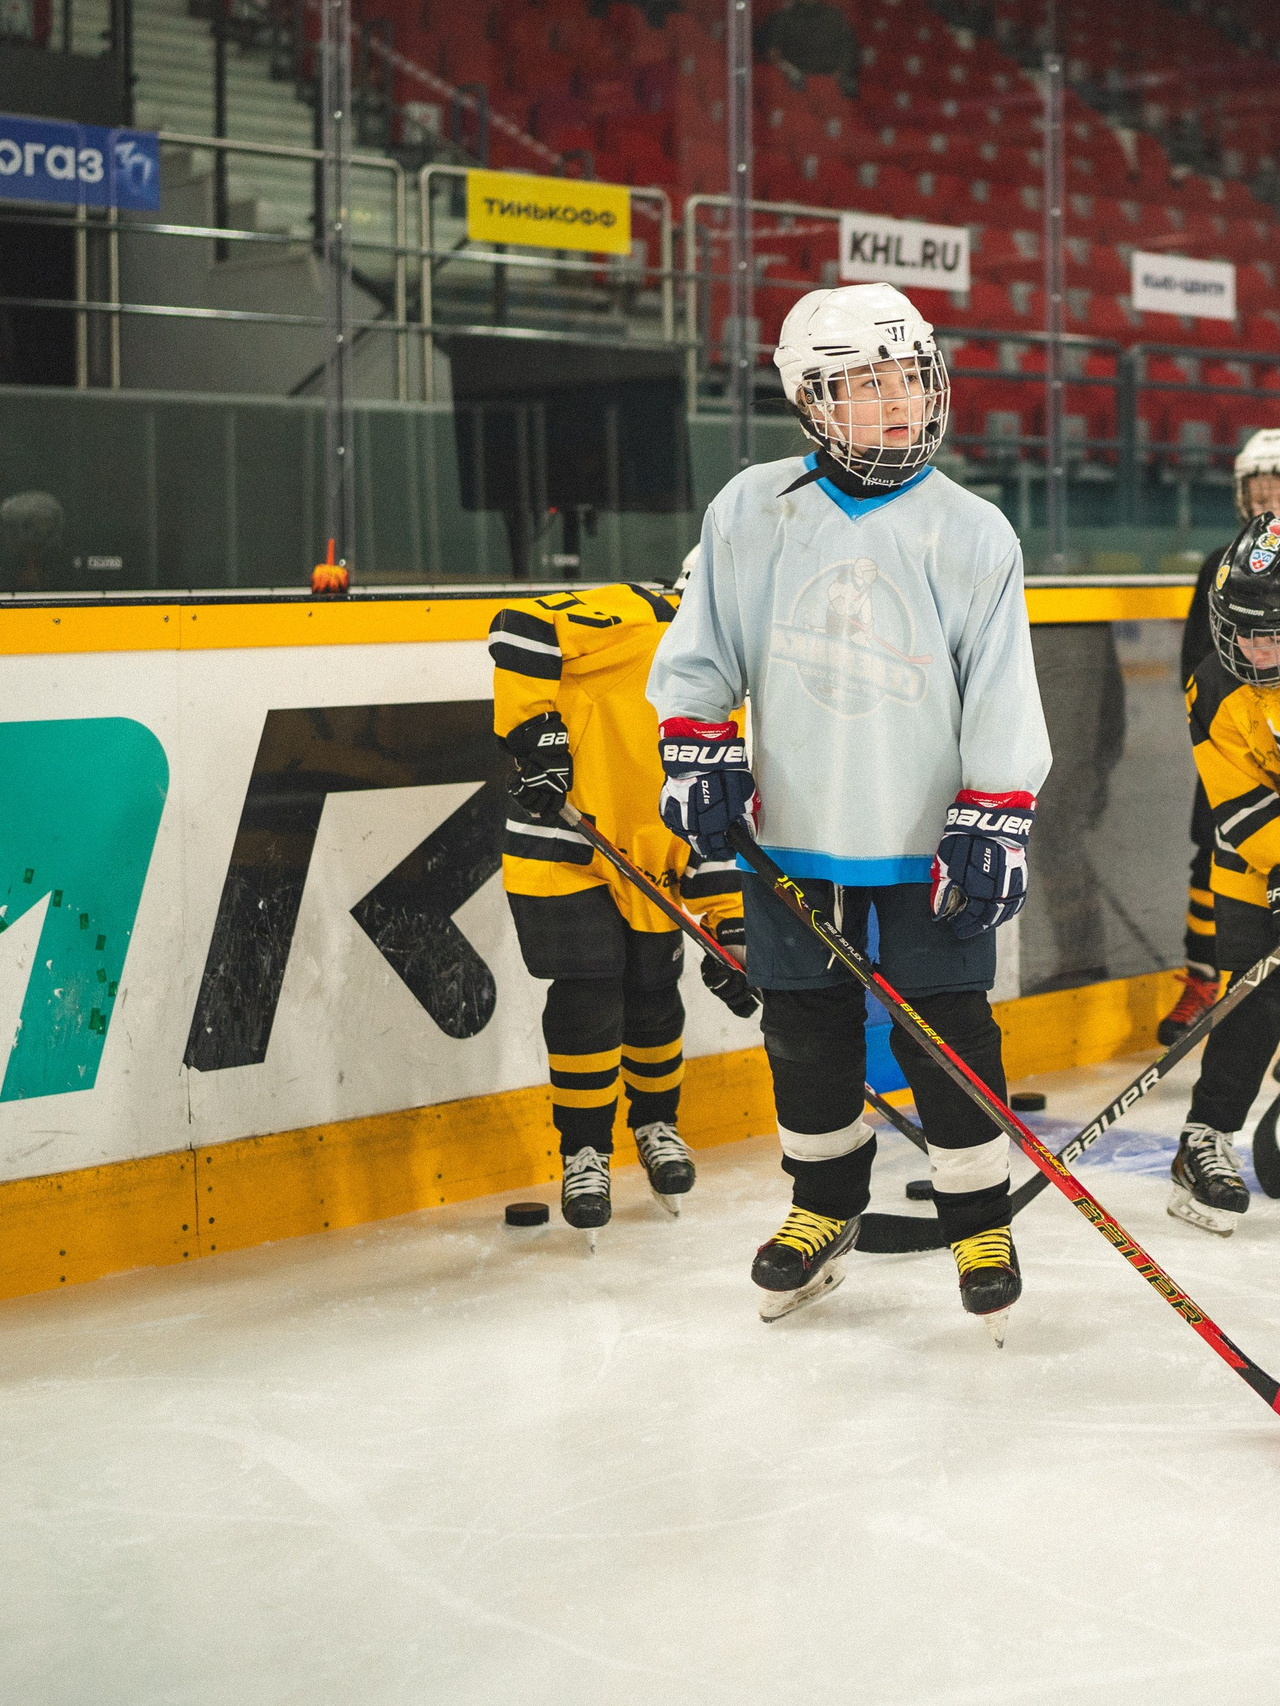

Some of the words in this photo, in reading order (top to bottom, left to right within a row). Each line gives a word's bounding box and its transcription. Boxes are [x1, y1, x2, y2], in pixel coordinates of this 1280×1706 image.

[483, 197, 617, 229] ТИНЬКОФФ
[850, 231, 960, 272] KHL.RU
[1033, 1140, 1071, 1177] JUNIOR
